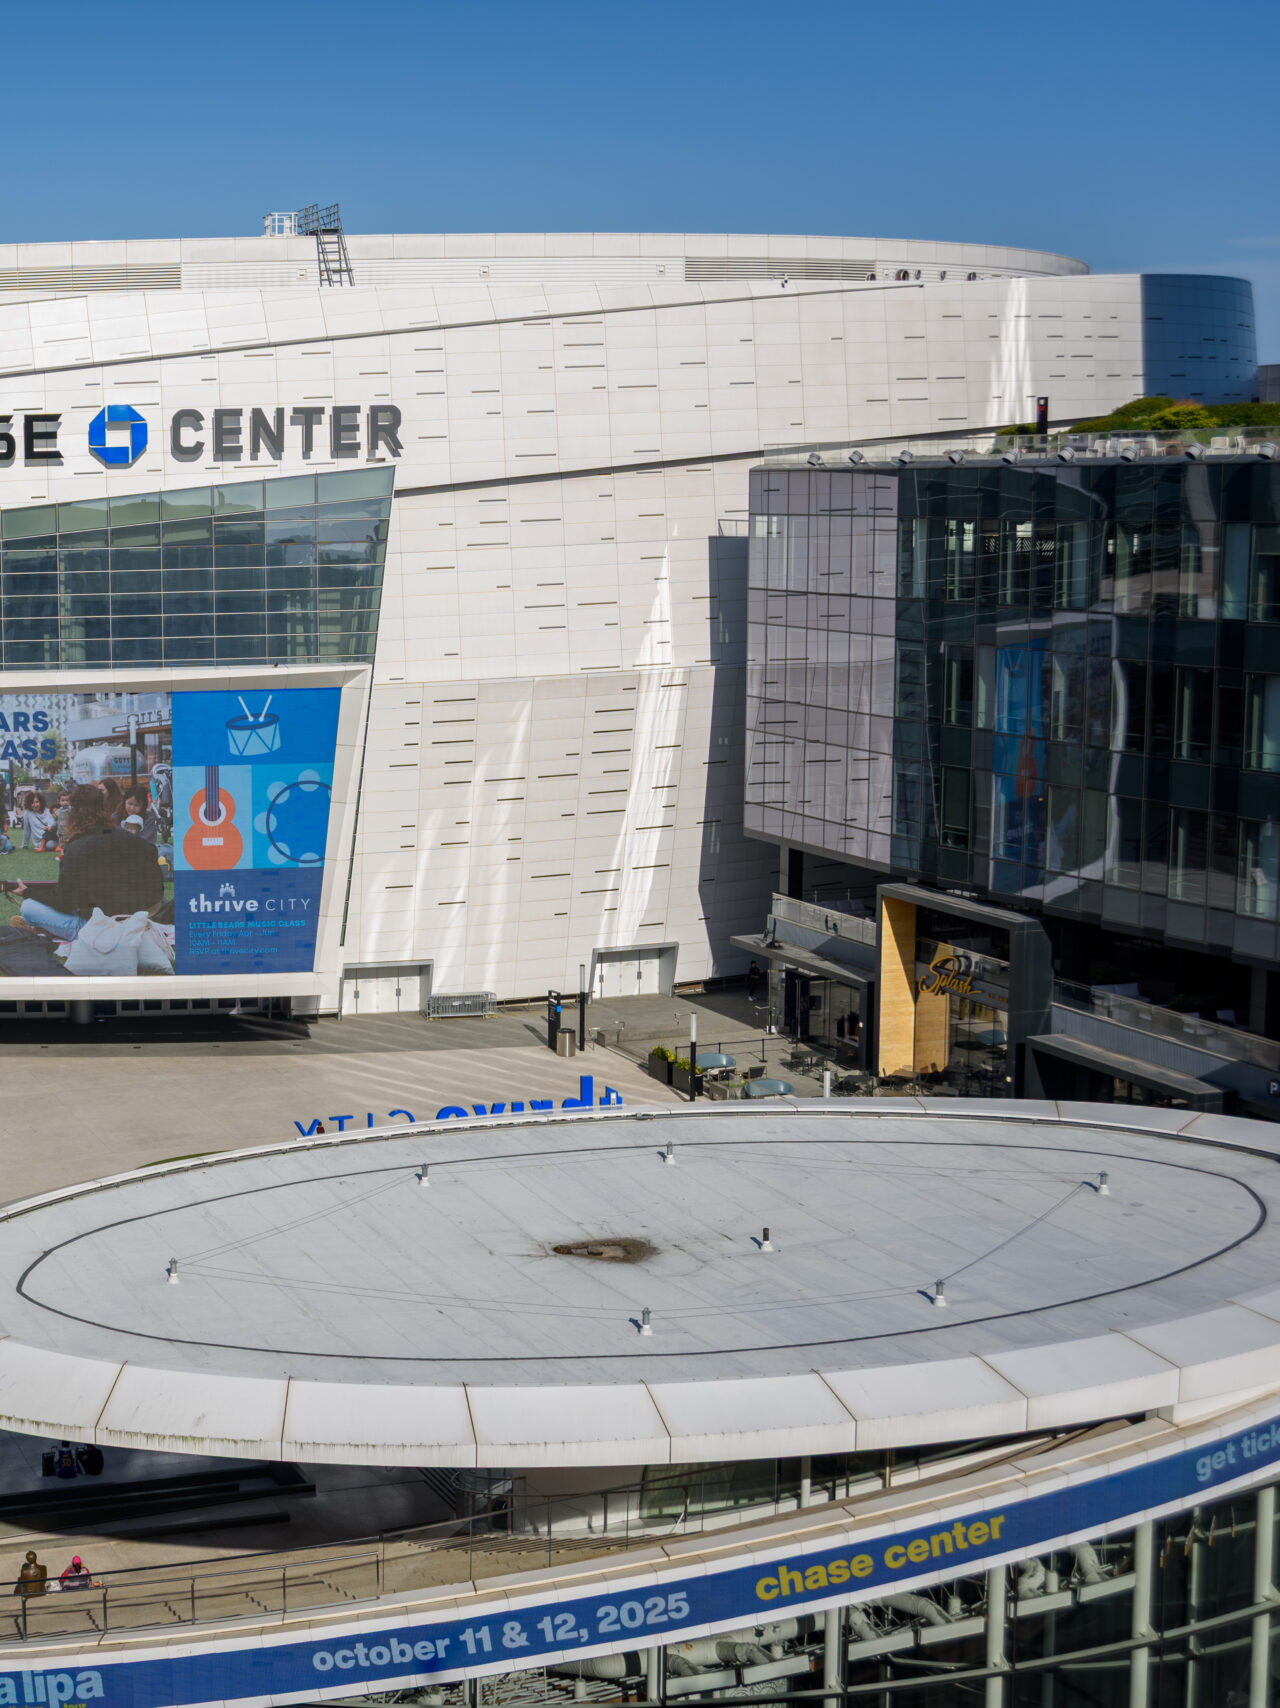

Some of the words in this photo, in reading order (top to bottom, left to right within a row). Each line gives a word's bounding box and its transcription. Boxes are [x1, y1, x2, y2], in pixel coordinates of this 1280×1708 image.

[171, 405, 405, 458] CENTER
[189, 893, 259, 912] thrive
[265, 898, 310, 911] CITY
[189, 931, 210, 939] Every
[918, 955, 983, 997] Splash
[1196, 1440, 1236, 1481] get
[755, 1548, 873, 1600] chase
[884, 1514, 1005, 1569] center
[312, 1636, 450, 1671] october
[459, 1626, 492, 1655] 11
[502, 1621, 530, 1648] &
[537, 1612, 588, 1643] 12,
[597, 1592, 691, 1634] 2025
[21, 1670, 105, 1708] lipa
